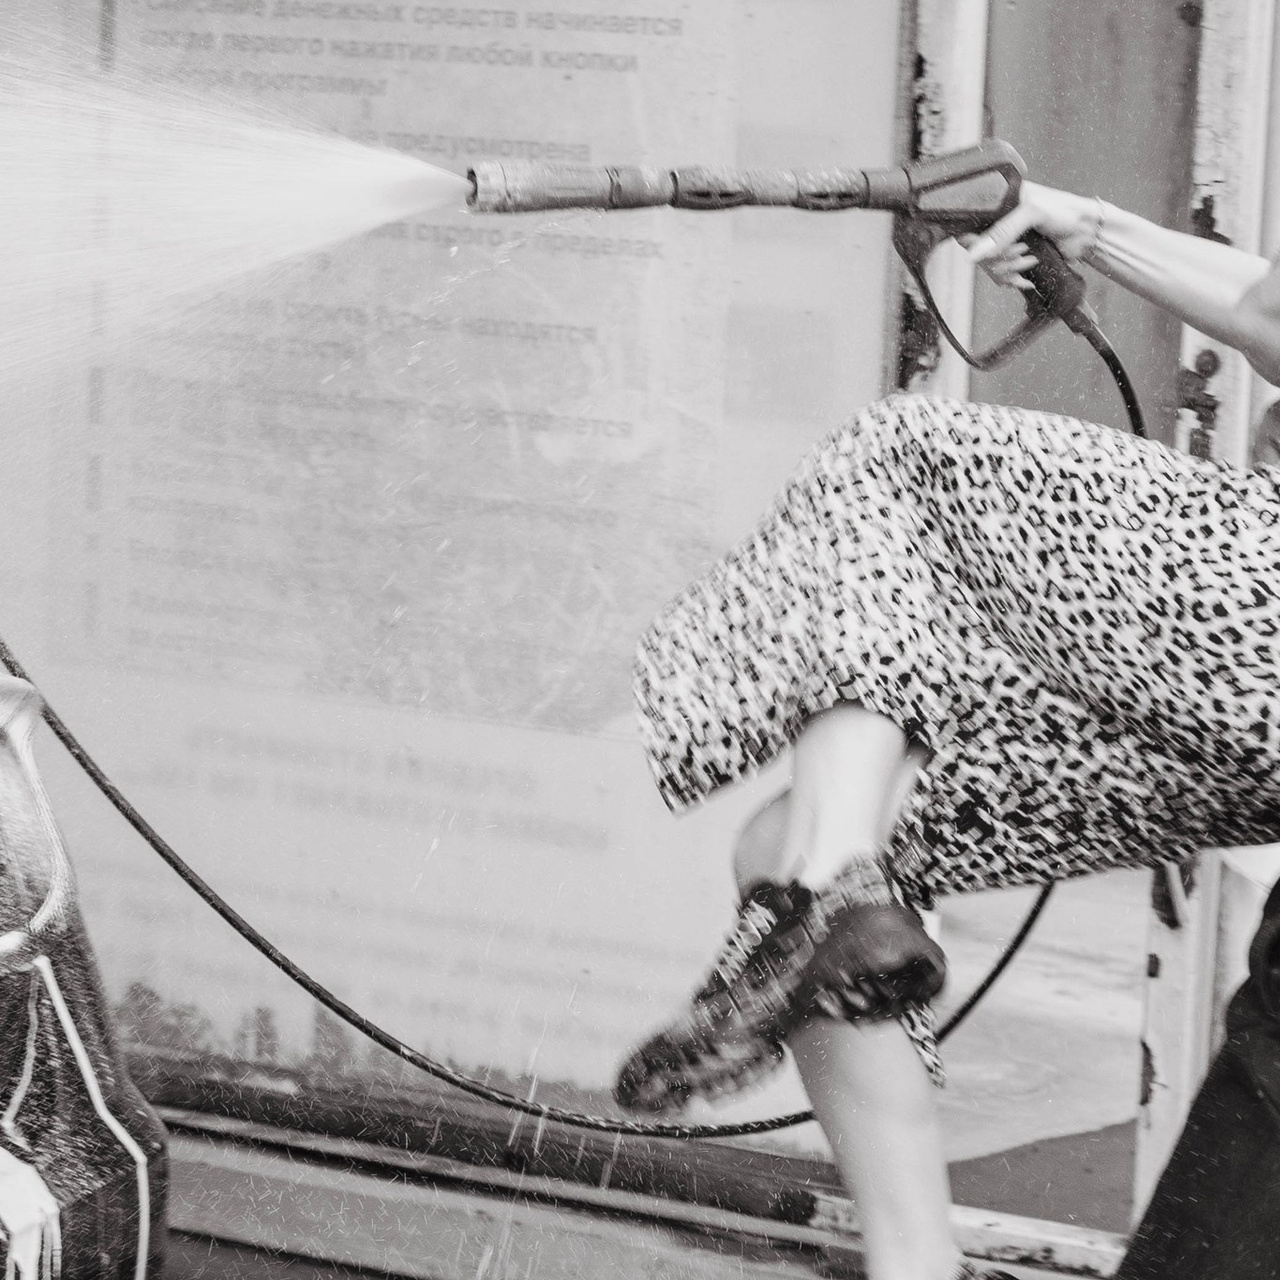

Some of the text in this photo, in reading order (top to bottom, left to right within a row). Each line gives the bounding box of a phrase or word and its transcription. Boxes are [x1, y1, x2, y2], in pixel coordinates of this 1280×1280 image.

[412, 5, 519, 32] средств
[525, 9, 684, 37] начинается
[222, 32, 325, 57] первого
[328, 38, 440, 62] нажатия
[444, 40, 534, 68] любой
[540, 49, 639, 74] кнопки
